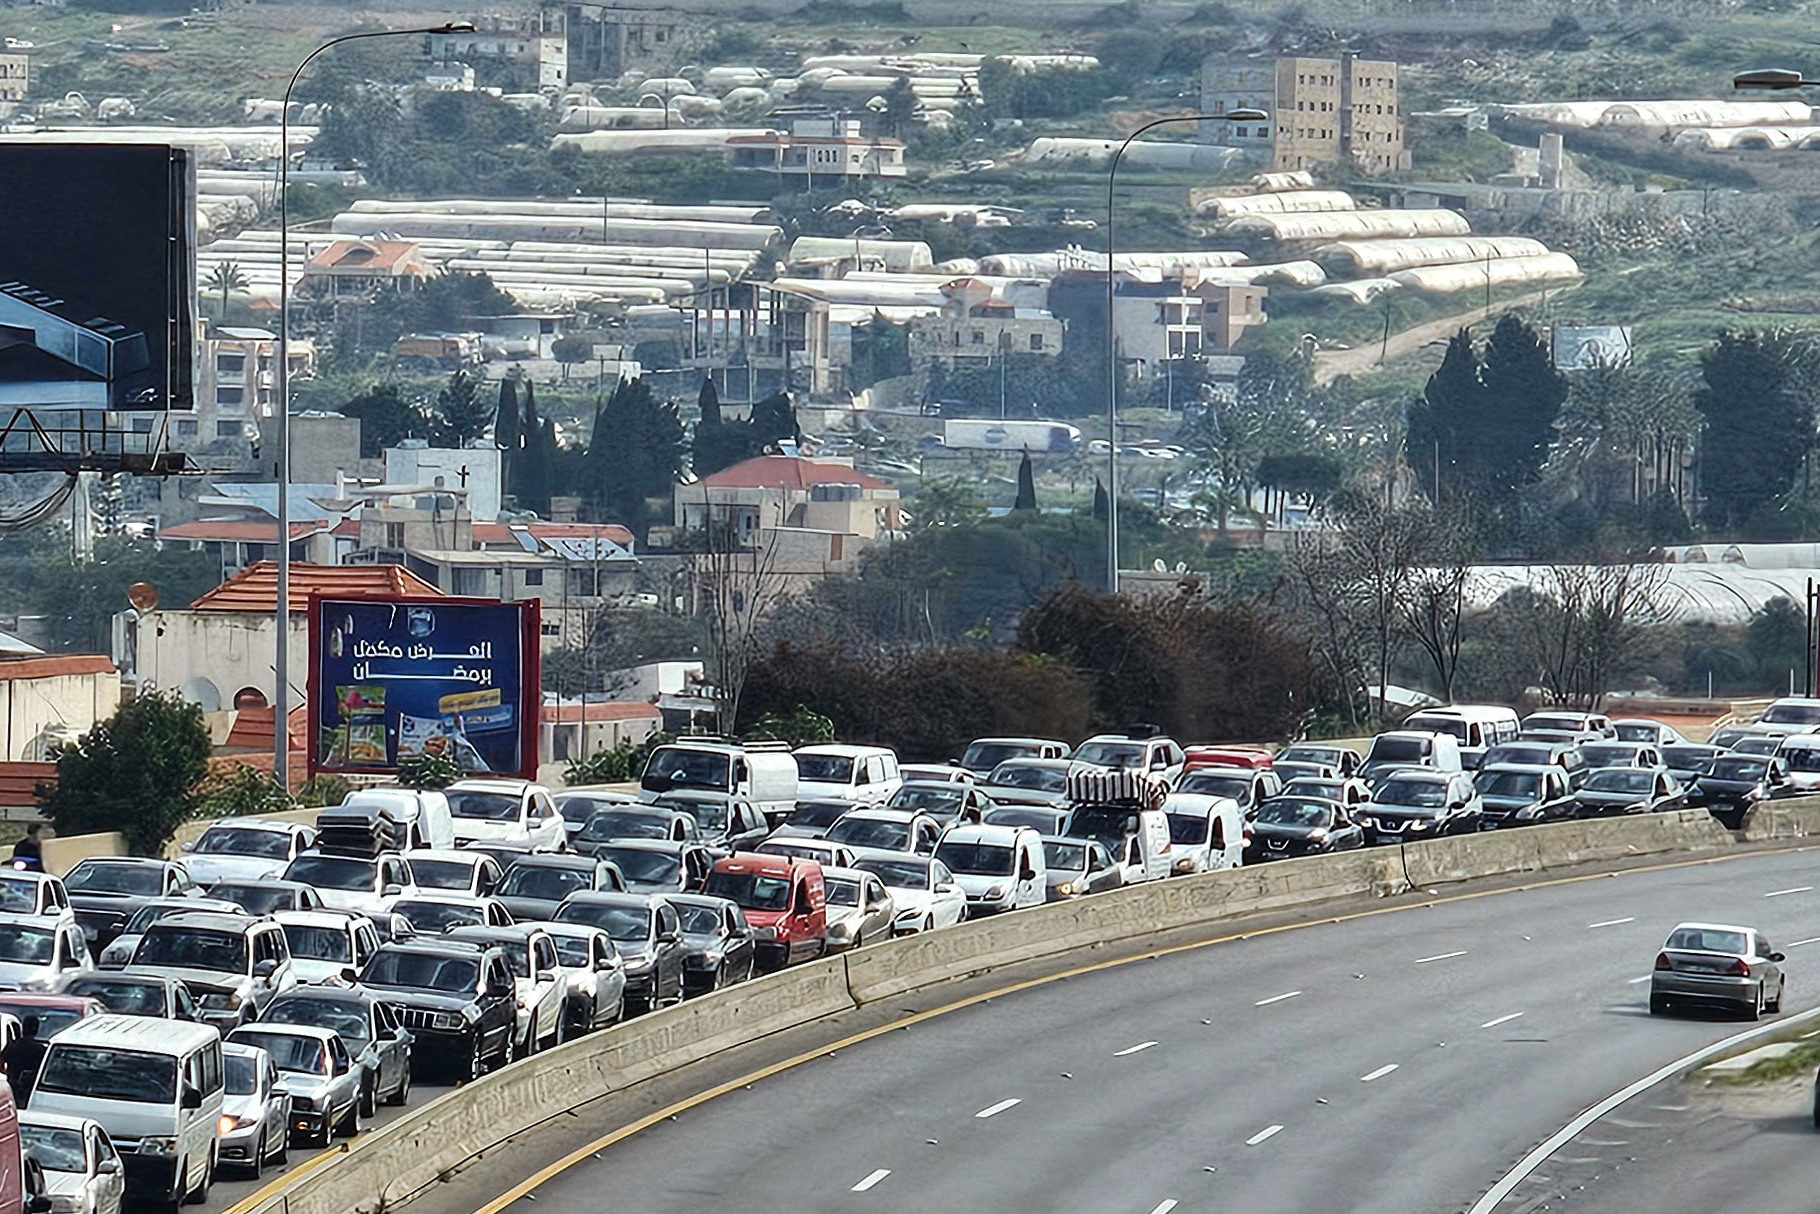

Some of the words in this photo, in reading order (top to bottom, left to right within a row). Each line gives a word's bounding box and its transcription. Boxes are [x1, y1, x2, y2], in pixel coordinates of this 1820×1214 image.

[353, 640, 403, 657] مكمل
[407, 641, 492, 660] العرض
[353, 661, 492, 685] برمضان
